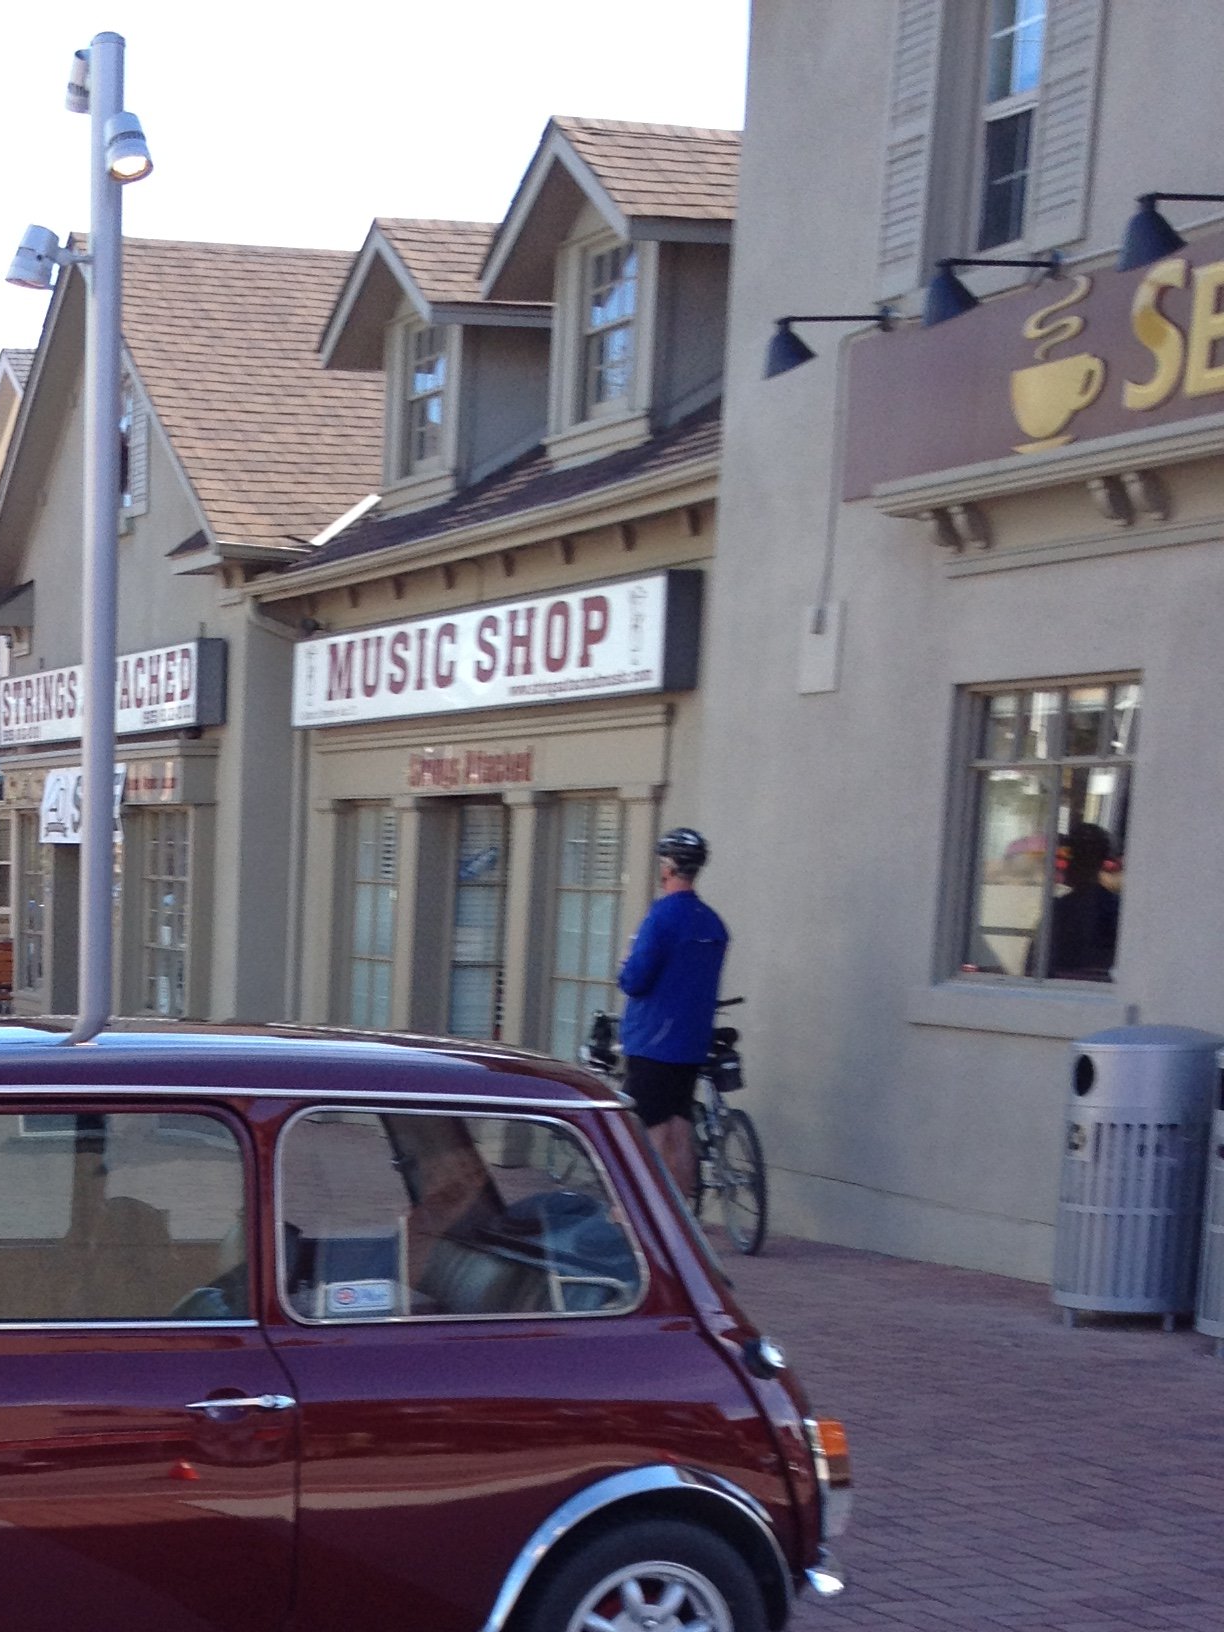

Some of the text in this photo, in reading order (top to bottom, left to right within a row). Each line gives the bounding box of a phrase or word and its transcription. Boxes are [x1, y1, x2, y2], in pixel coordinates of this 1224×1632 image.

[2, 648, 193, 727] STRINGS ACHED
[327, 622, 457, 701] MUSIC
[474, 595, 609, 684] SHOP
